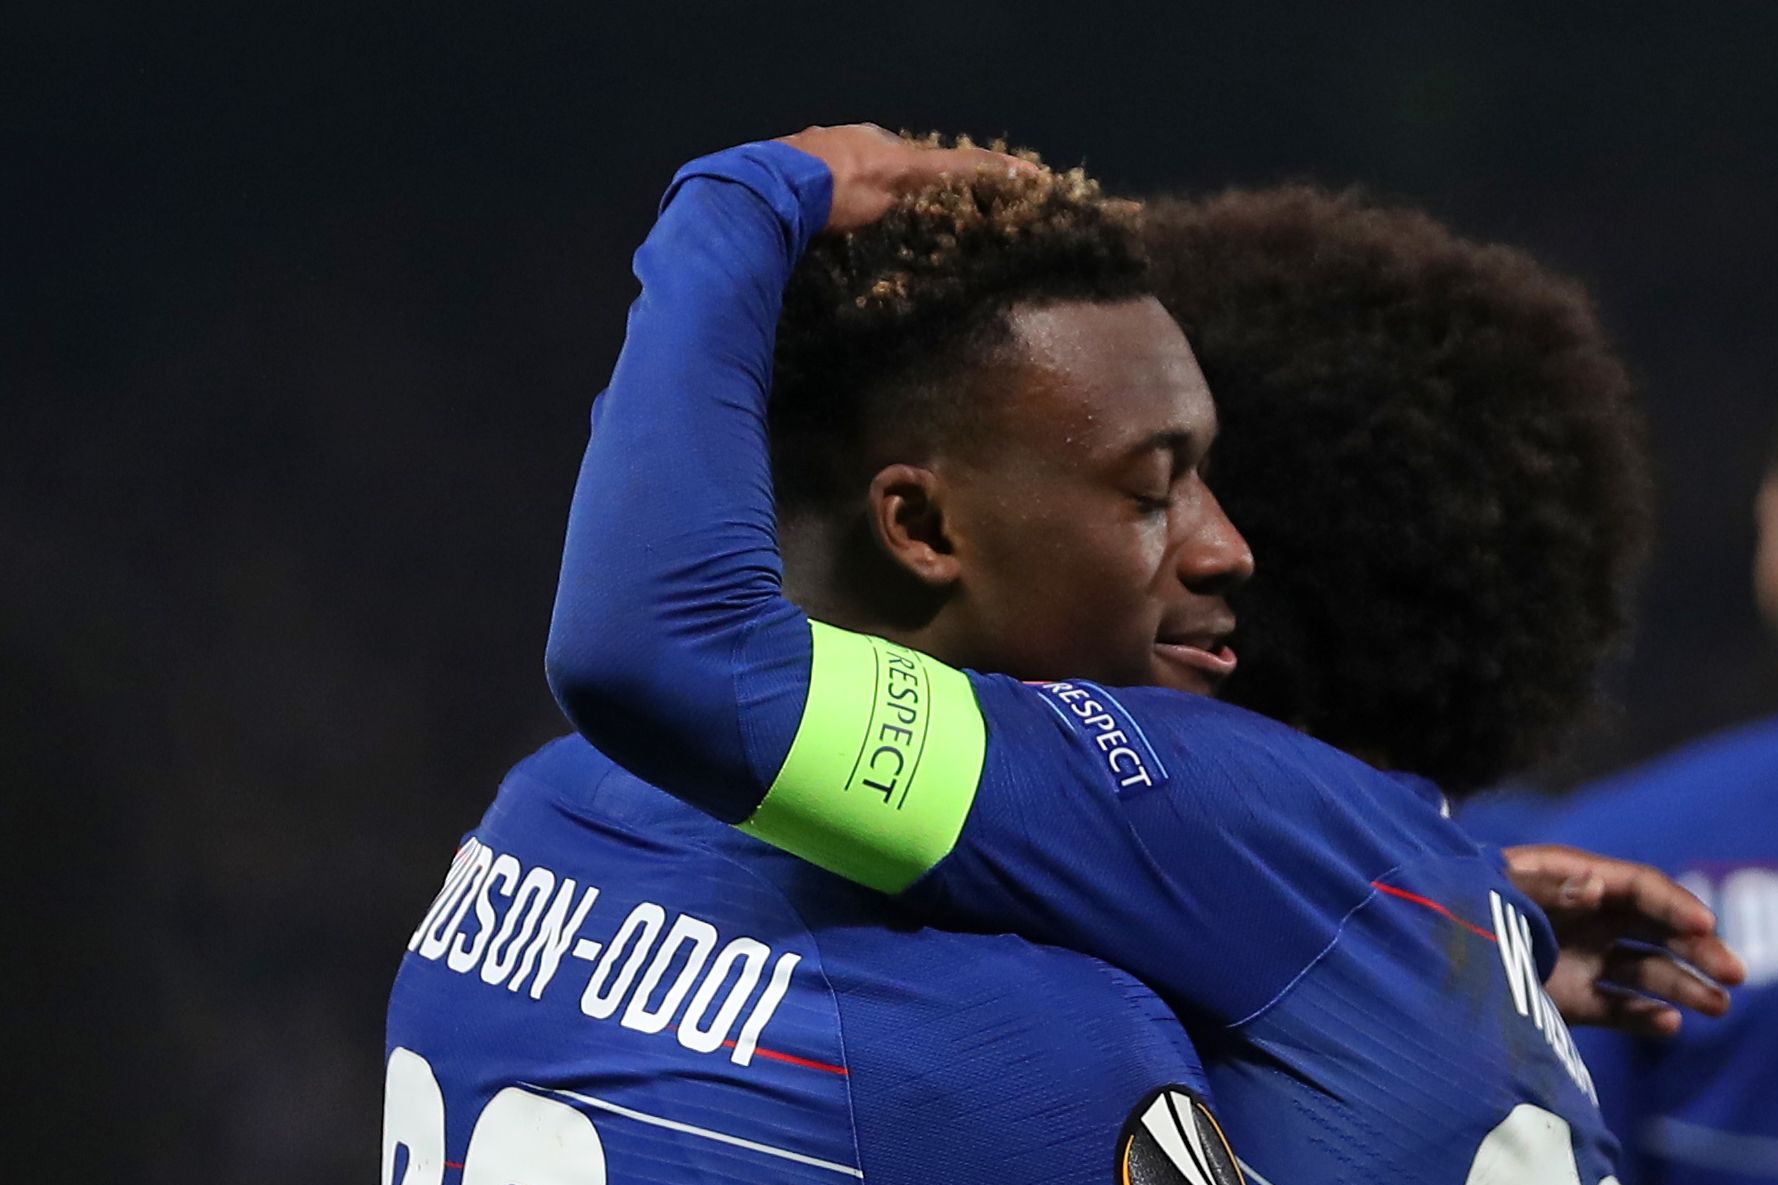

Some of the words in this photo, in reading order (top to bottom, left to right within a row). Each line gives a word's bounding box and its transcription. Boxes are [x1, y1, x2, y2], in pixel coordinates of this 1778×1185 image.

[862, 651, 919, 805] RESPECT
[1042, 682, 1152, 787] RESPECT
[407, 836, 802, 1067] DSON-ODOI
